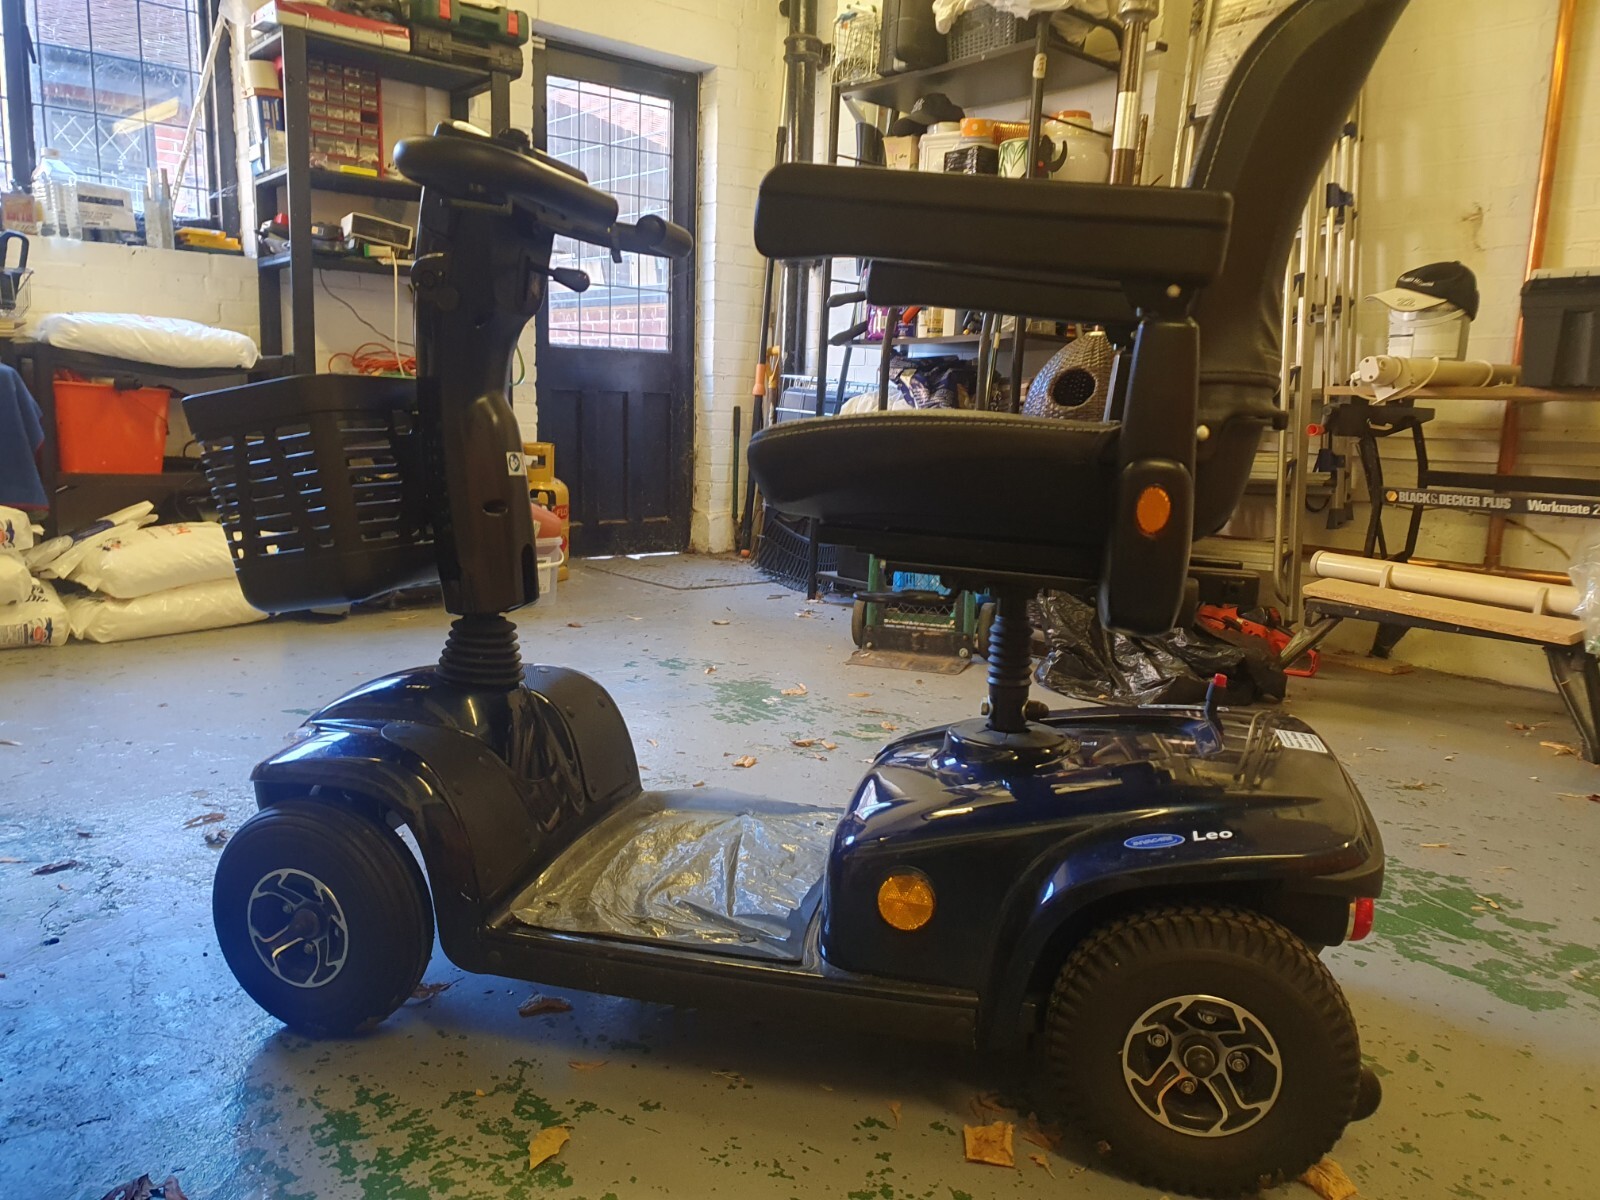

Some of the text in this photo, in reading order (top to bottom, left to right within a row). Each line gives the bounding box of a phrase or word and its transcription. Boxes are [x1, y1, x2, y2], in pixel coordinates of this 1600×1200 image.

[1482, 497, 1512, 509] PLUS
[1527, 500, 1591, 515] Workmate
[1192, 830, 1233, 842] Leo
